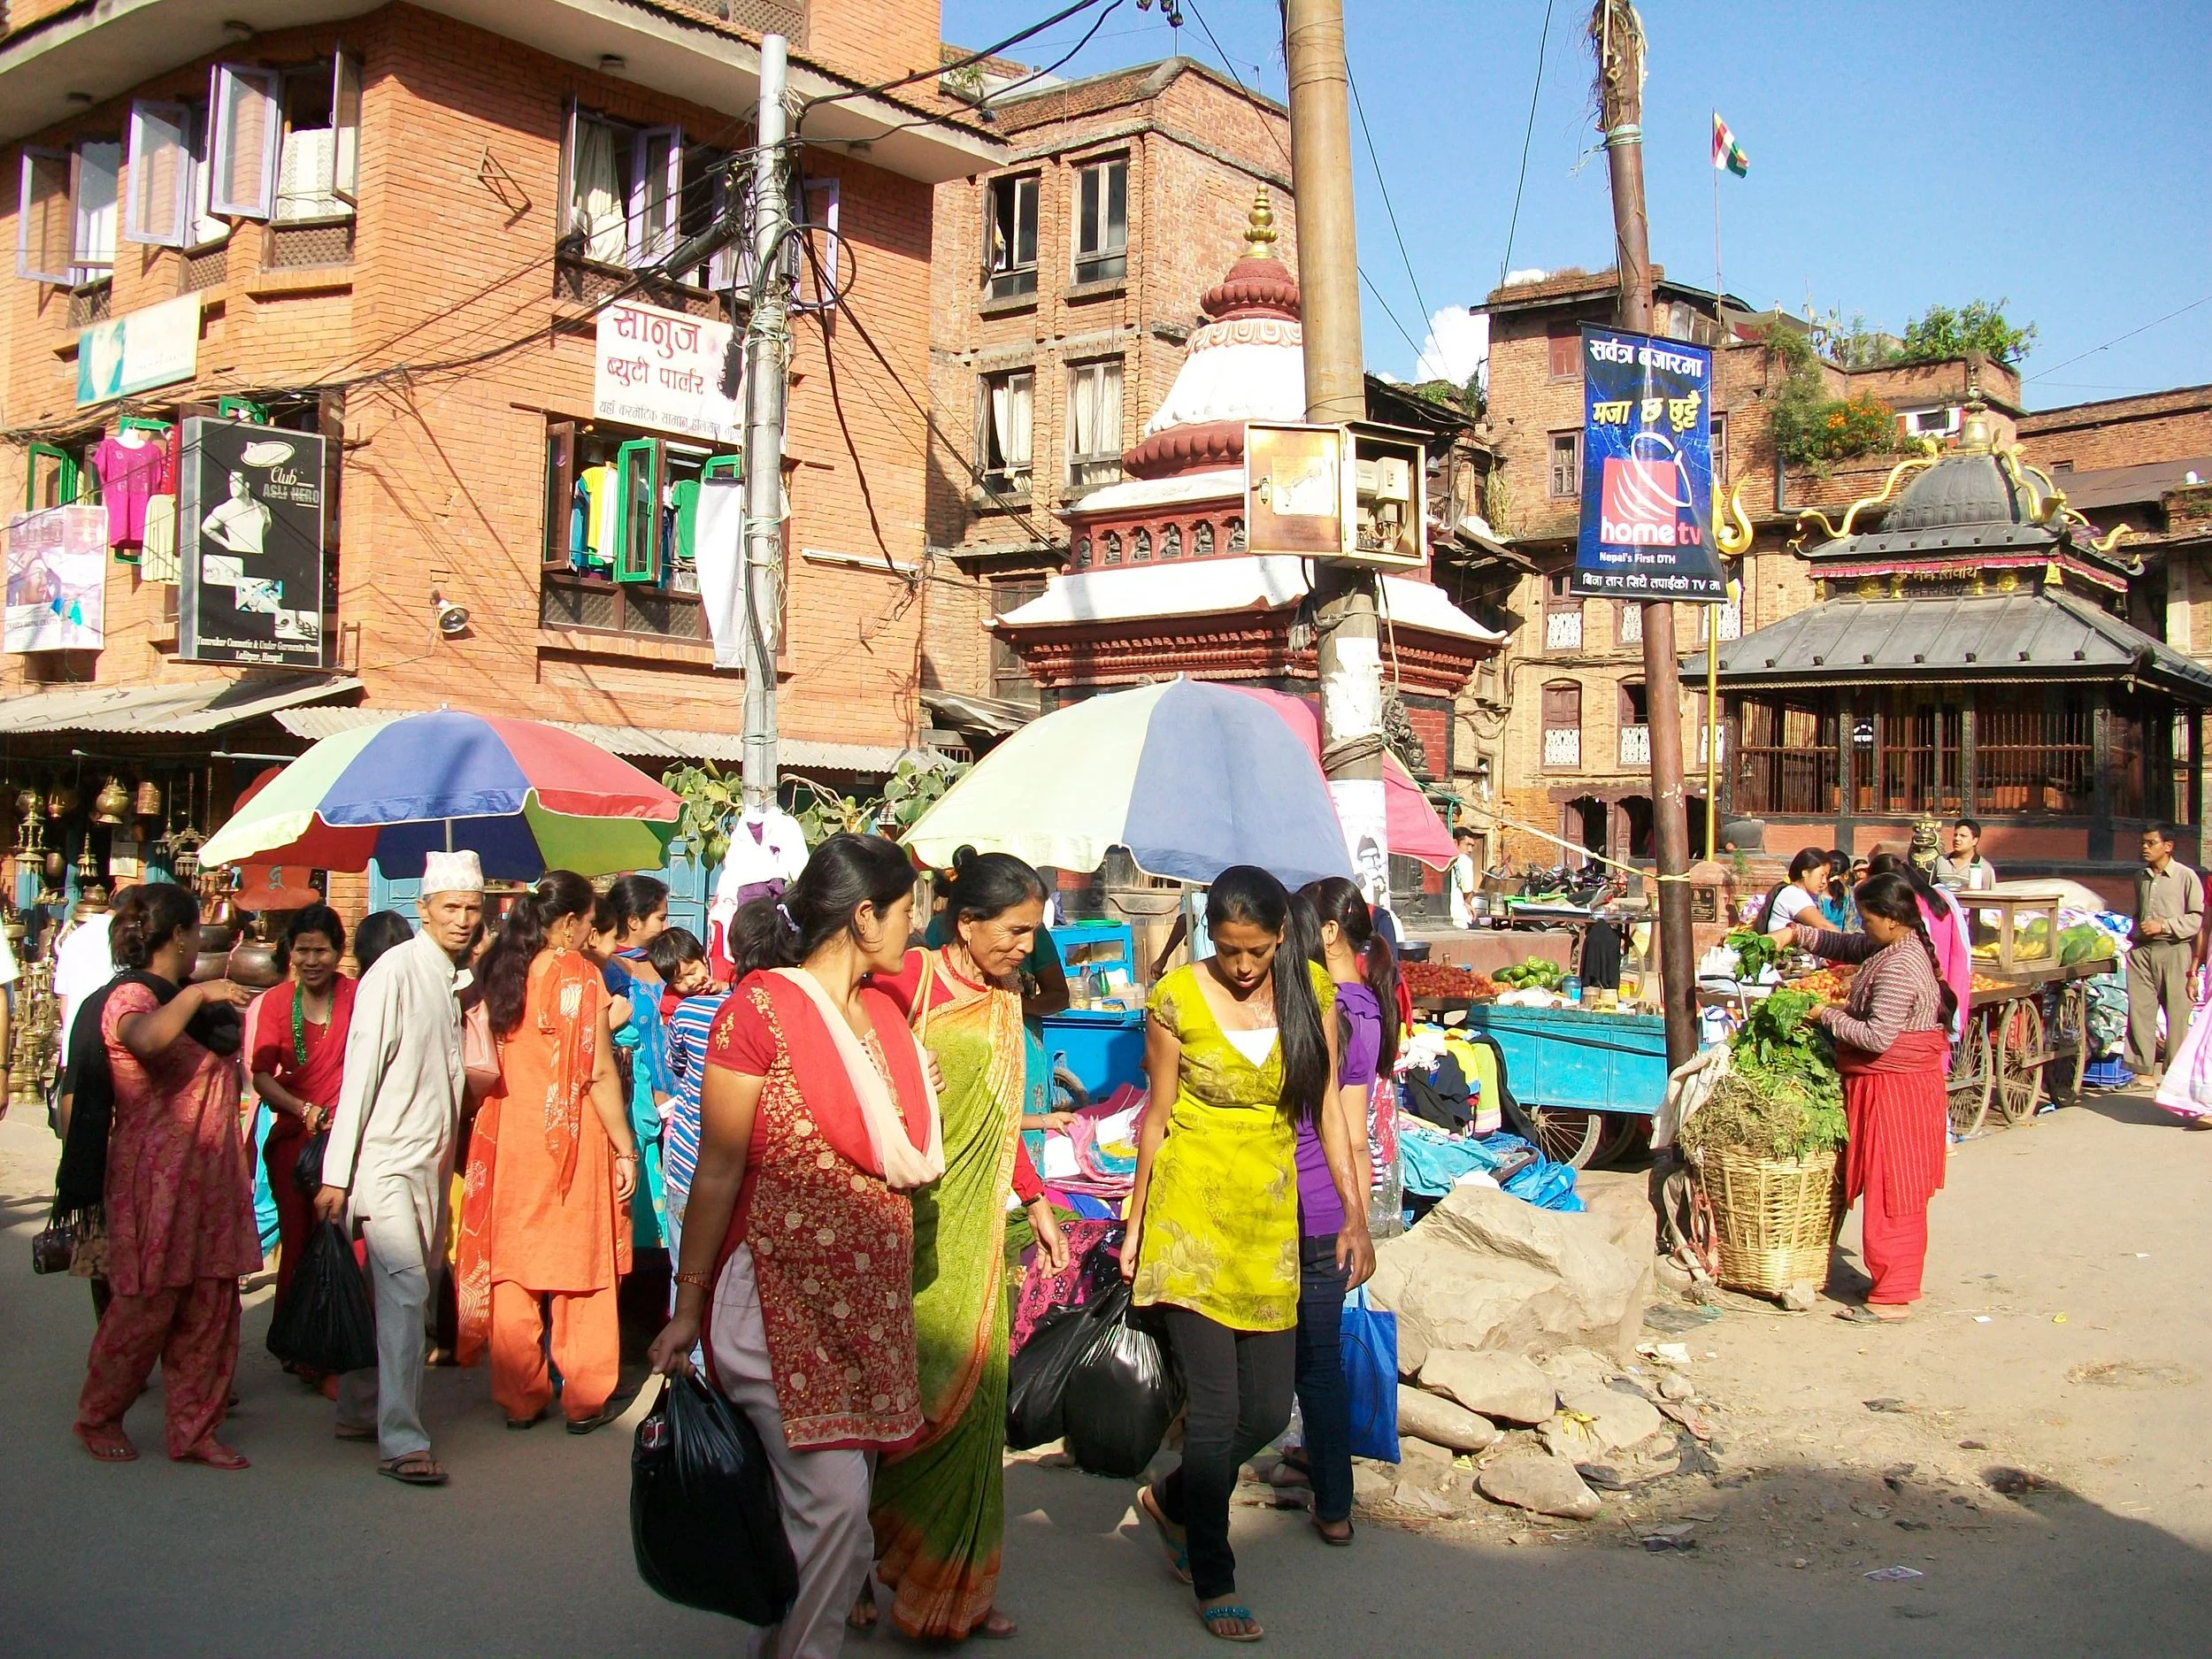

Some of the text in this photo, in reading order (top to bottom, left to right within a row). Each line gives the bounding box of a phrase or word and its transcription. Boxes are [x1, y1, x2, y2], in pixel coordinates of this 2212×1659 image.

[613, 304, 702, 359] सानुज
[1589, 338, 1702, 377] सर्वत्र बजारमा
[659, 367, 703, 395] पार्लर
[1593, 401, 1632, 425] मजा
[1640, 398, 1663, 423] छ
[271, 466, 296, 485] Club
[1601, 516, 1701, 545] home tv
[1599, 551, 1676, 564] Nepal's First DTH
[1605, 576, 1624, 588] तार
[1692, 580, 1706, 590] TV
